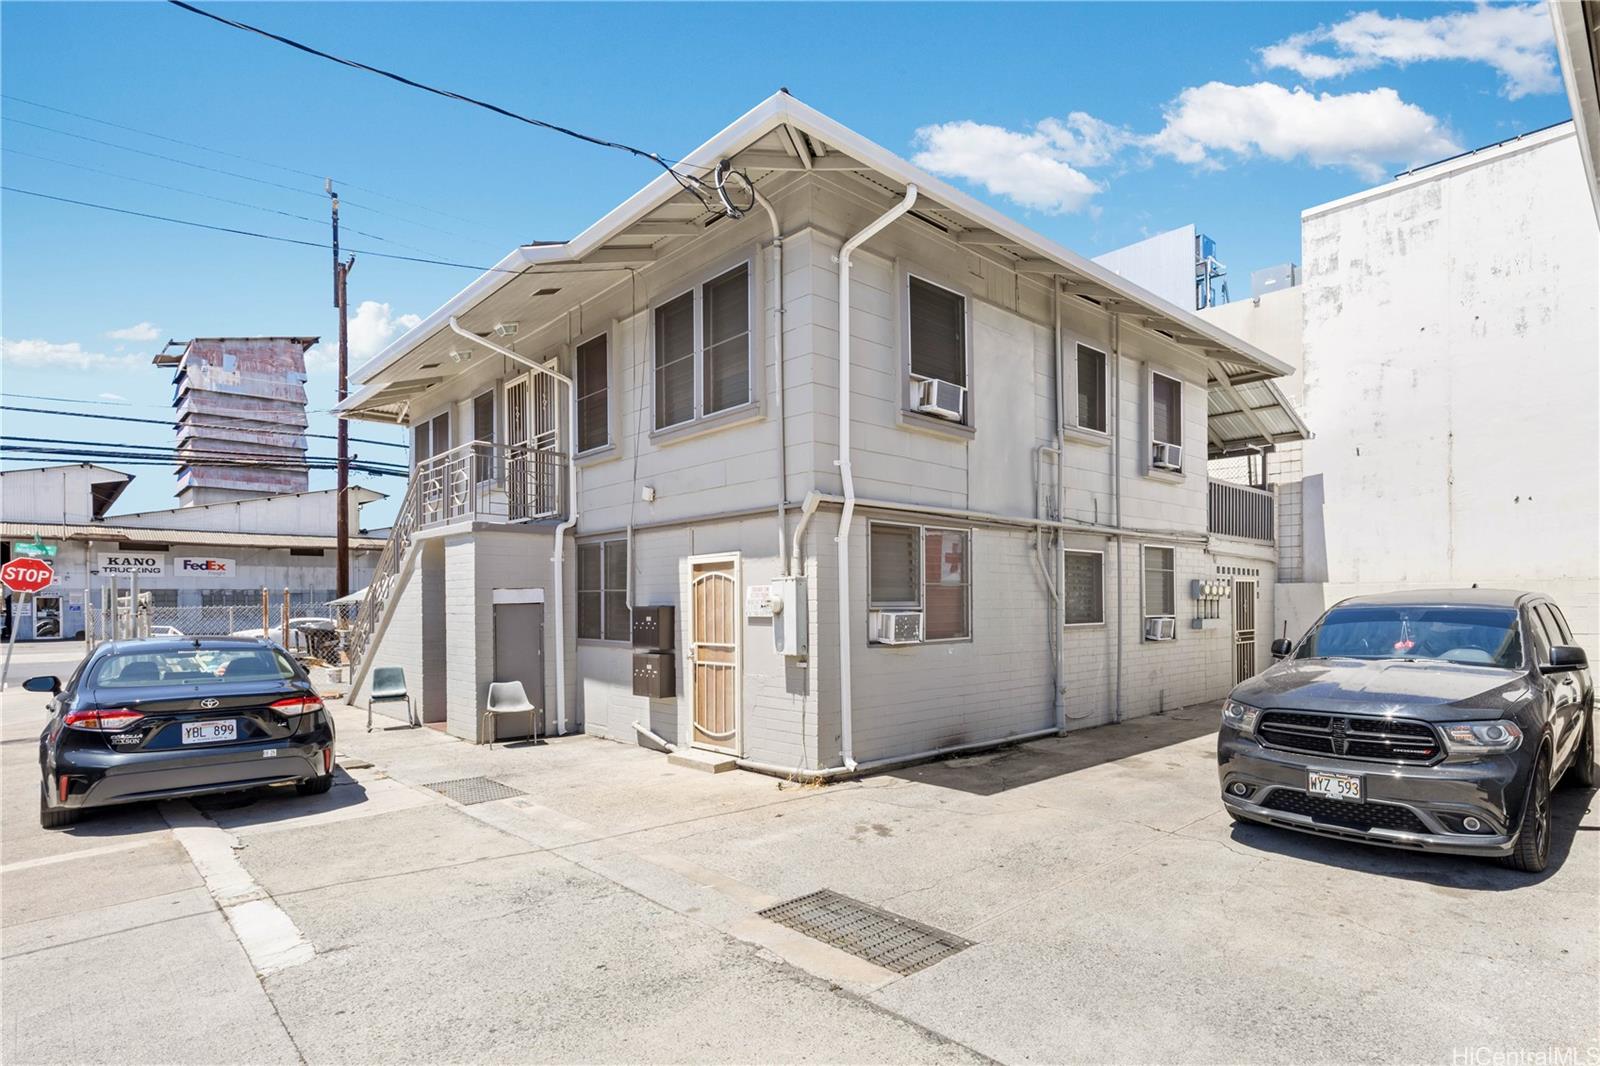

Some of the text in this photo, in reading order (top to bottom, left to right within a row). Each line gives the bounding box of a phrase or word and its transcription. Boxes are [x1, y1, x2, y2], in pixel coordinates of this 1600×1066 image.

[107, 557, 156, 566] KANO
[183, 559, 226, 571] FedEx
[4, 566, 50, 583] STOP
[185, 726, 207, 738] YBL
[213, 724, 234, 736] 899
[1337, 780, 1360, 796] 593
